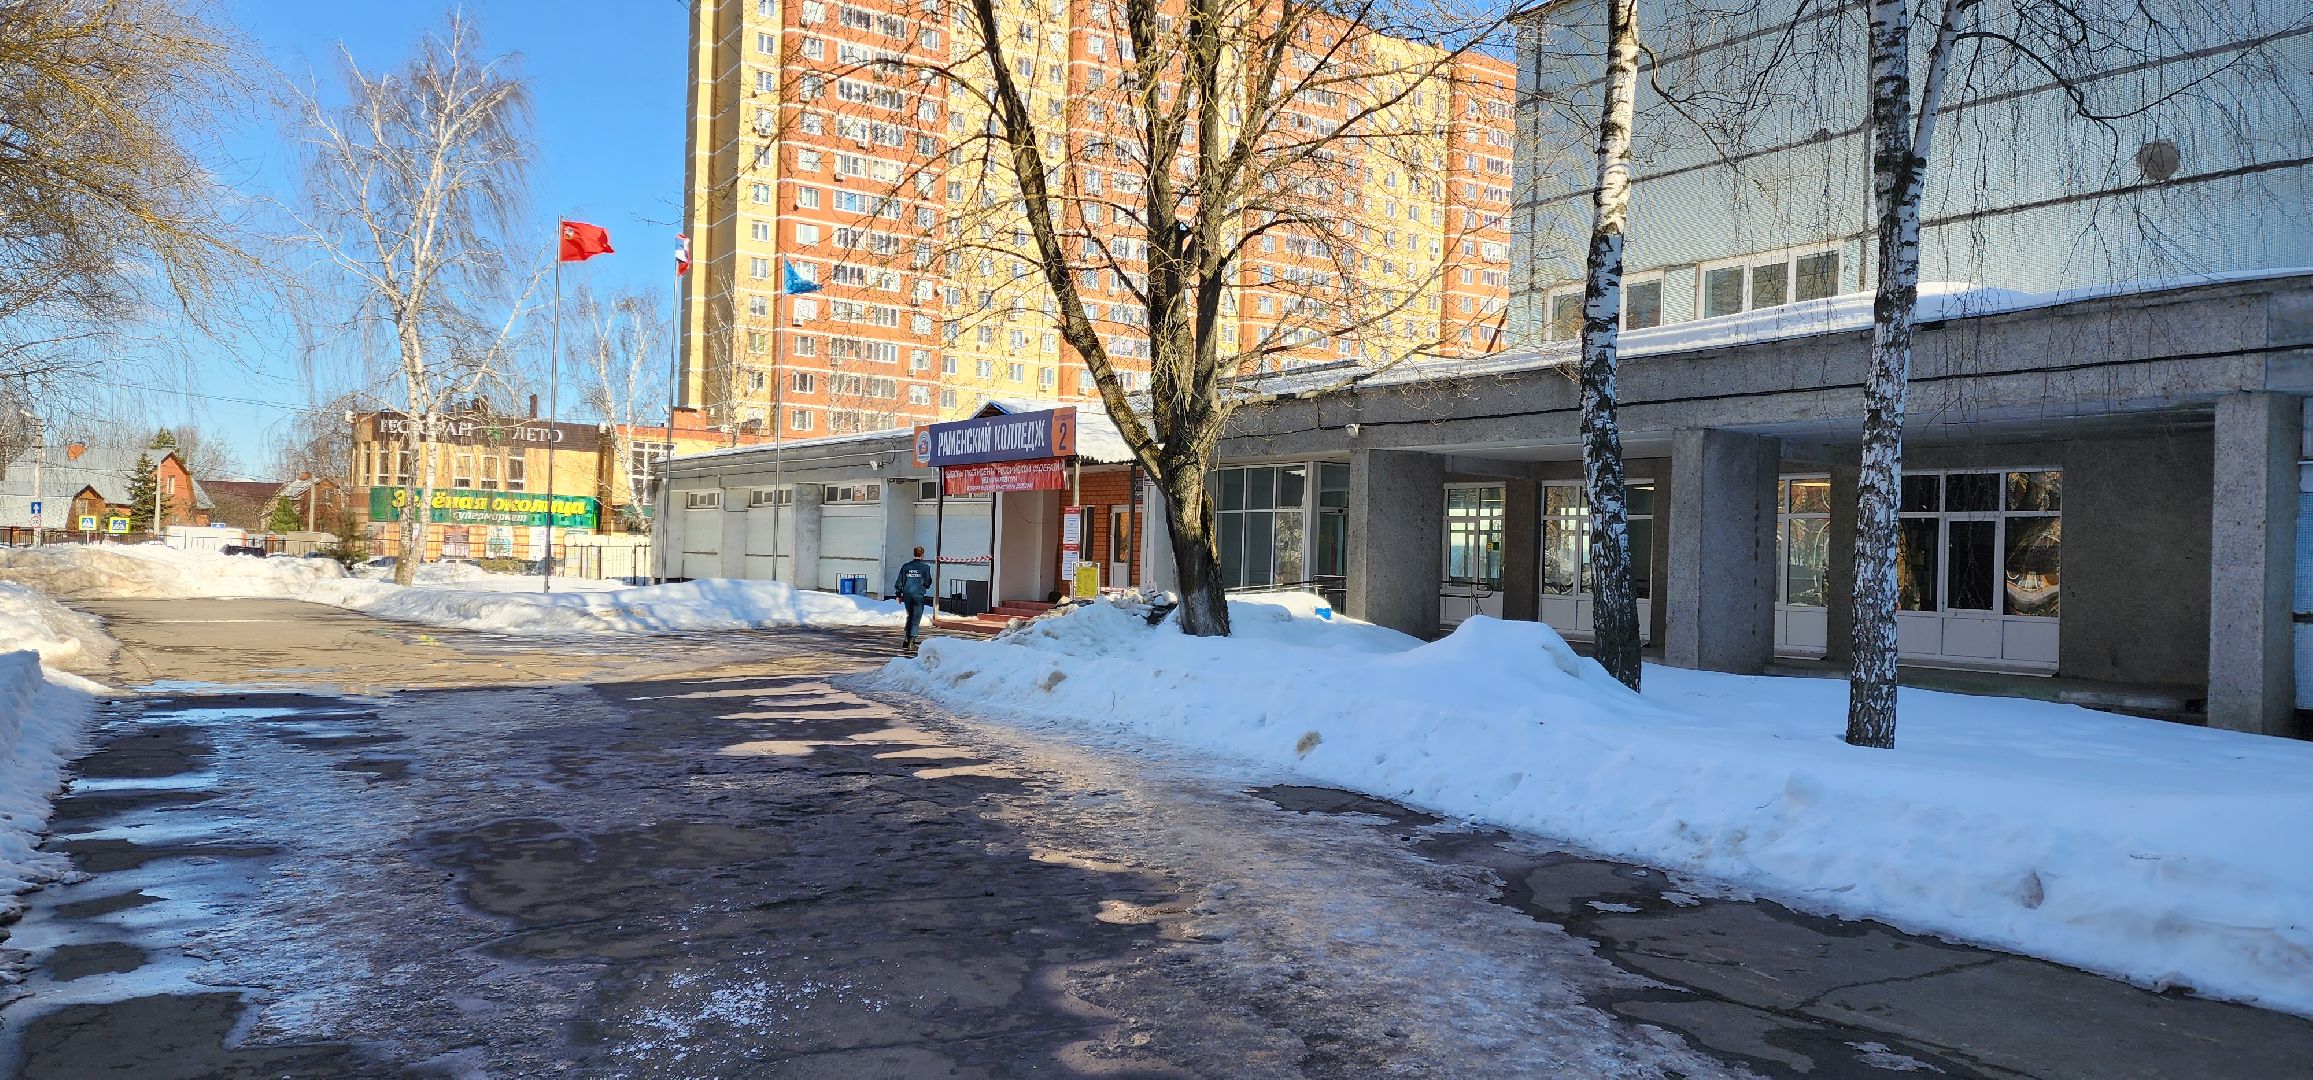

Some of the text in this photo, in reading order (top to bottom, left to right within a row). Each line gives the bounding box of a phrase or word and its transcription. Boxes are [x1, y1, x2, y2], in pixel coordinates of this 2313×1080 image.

[380, 419, 563, 443] РЕСОАН ЛЕТО
[938, 420, 1045, 456] РАМЕНСКИЙ КОЛЛЕДЖ
[1058, 422, 1067, 451] 2
[391, 489, 586, 516] Зёная околица
[453, 510, 527, 523] супермаркет
